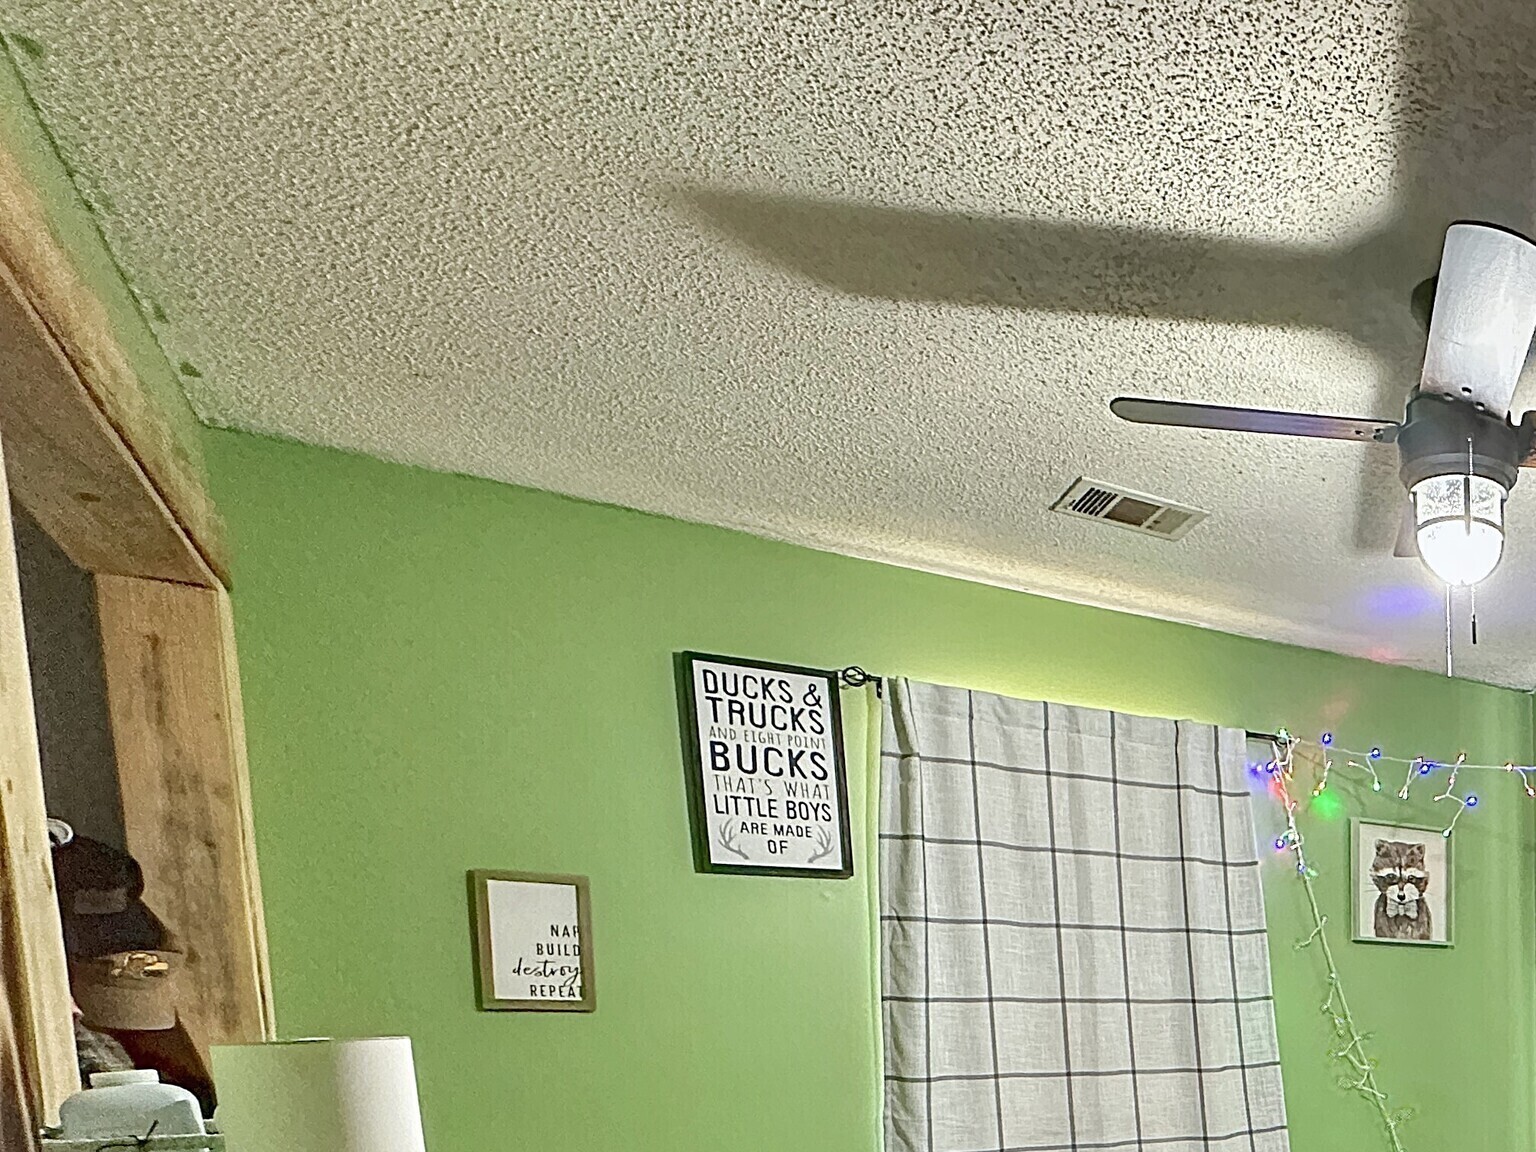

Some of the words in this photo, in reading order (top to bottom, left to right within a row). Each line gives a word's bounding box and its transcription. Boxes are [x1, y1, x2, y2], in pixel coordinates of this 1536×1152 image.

[702, 669, 793, 704] DUCKS
[802, 683, 823, 709] &
[705, 696, 824, 735] TRUCKS
[709, 726, 737, 740] AND
[744, 730, 781, 745] EIGHT
[787, 735, 826, 749] POINT
[710, 740, 828, 781] BUCKS
[714, 774, 773, 796] THAT'S
[784, 781, 830, 800] WHAT
[713, 794, 779, 819] LITTLE
[786, 800, 832, 822] BOYS
[740, 821, 767, 835] ARE
[774, 823, 812, 838] MADE
[768, 840, 788, 854] OF
[536, 943, 580, 957] BUILD
[512, 957, 582, 987] destroy
